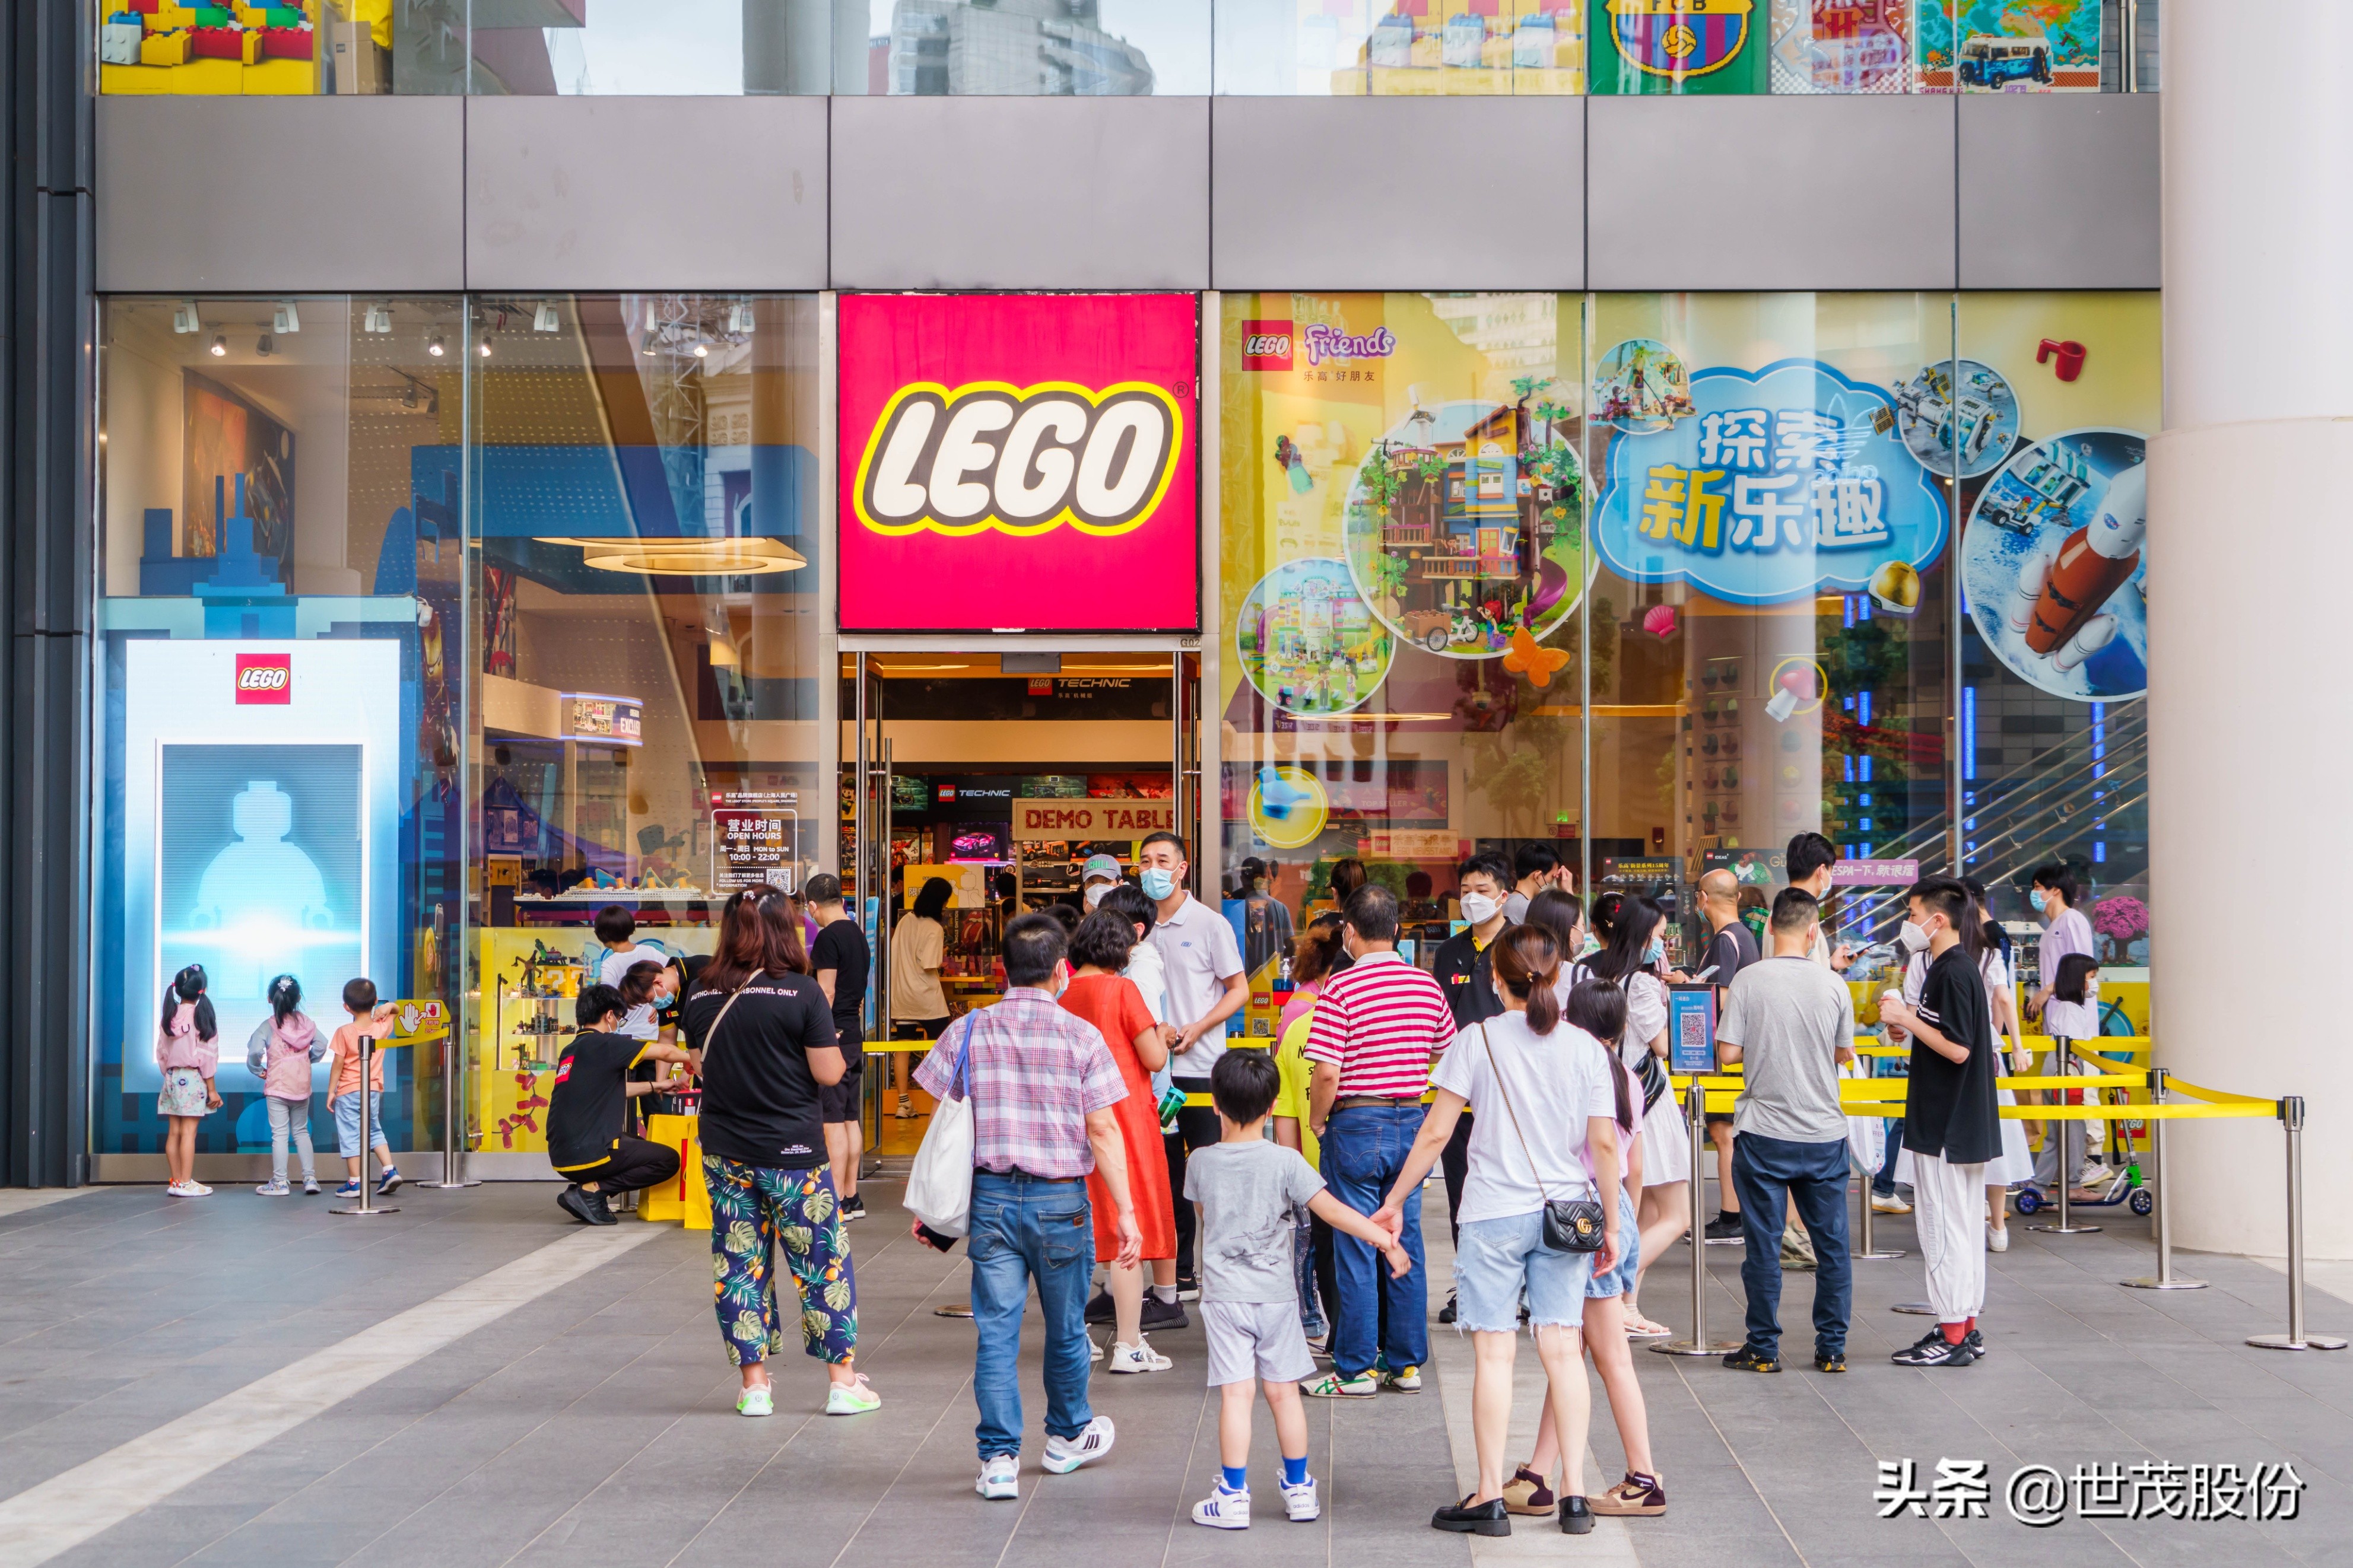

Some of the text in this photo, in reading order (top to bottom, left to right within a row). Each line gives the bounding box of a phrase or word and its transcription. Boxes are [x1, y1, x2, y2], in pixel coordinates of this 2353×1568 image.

[1244, 325, 1396, 365] LEGO Friends
[1700, 409, 1839, 469] 探索
[1639, 465, 1888, 548] 新乐趣
[1180, 638, 1201, 647] G02
[238, 667, 288, 690] LEGO
[1030, 678, 1132, 688] LEGO TECHNIC
[728, 819, 781, 832] 营业时间
[1026, 810, 1092, 829] DEMO
[1088, 860, 1110, 870] CHILL
[777, 988, 798, 997] ONLY
